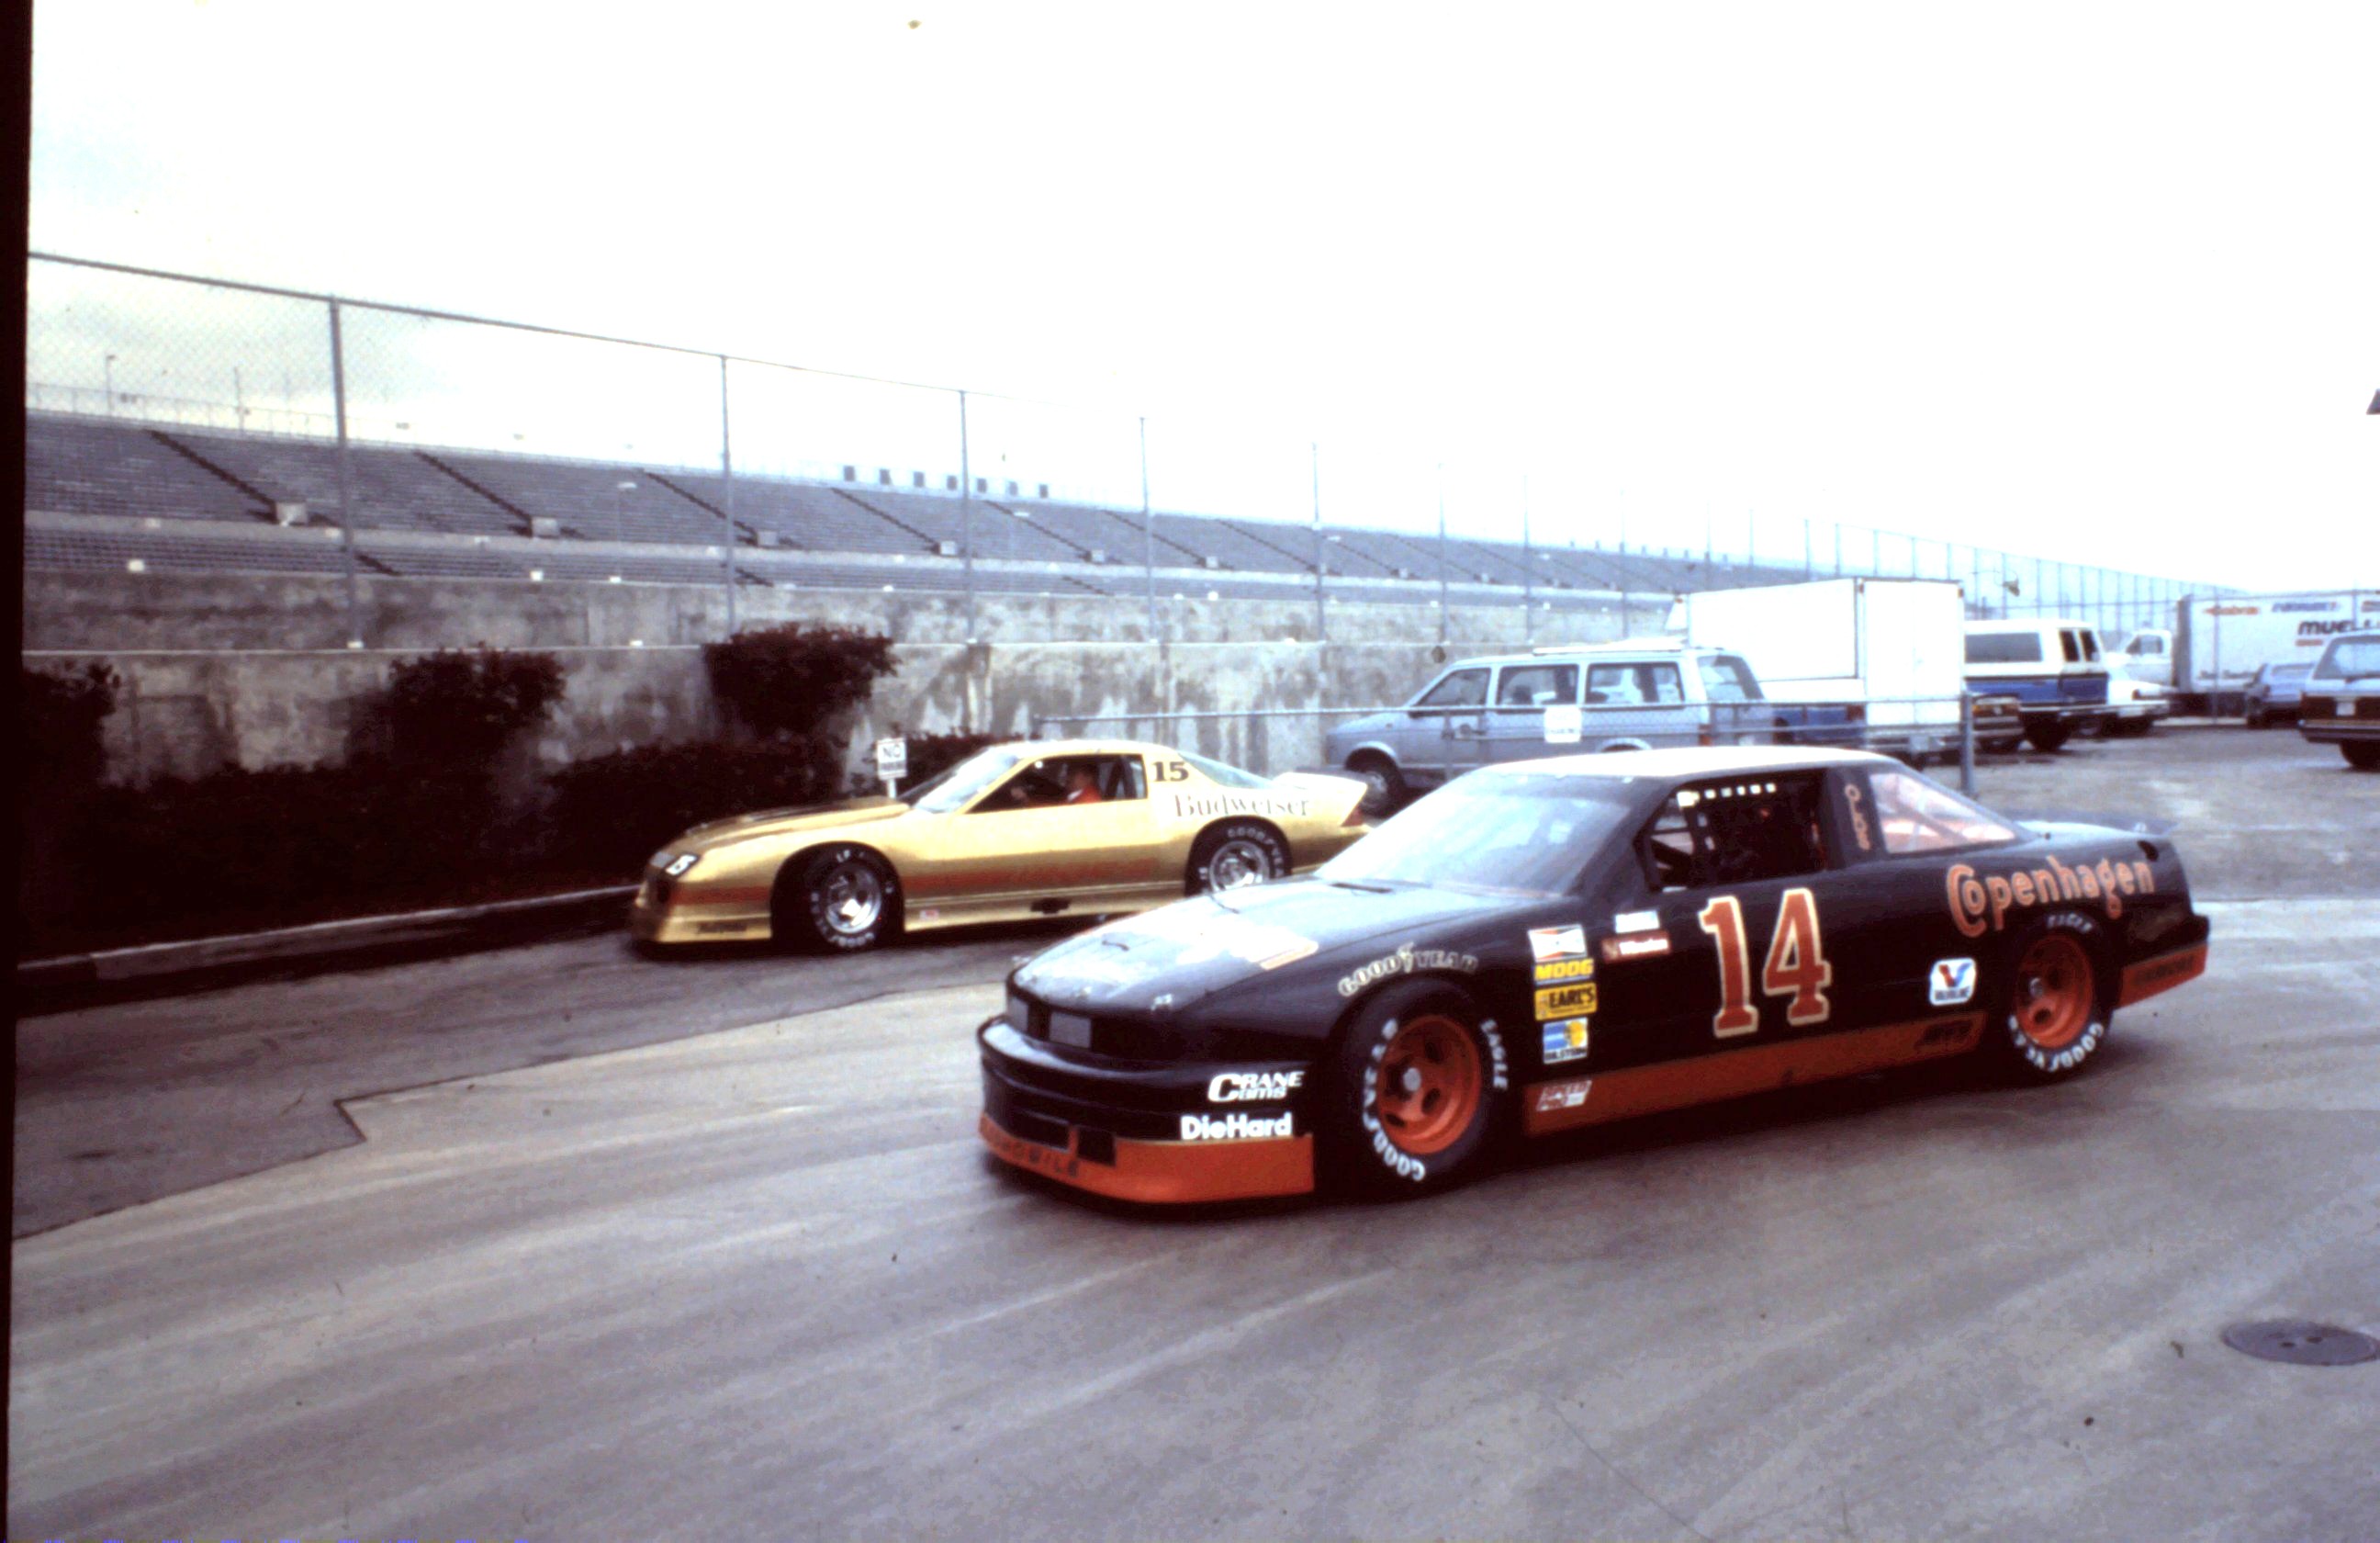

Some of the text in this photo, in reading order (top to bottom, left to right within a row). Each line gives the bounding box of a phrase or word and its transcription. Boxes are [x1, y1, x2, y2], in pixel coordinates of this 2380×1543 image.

[1153, 761, 1189, 782] 15
[1174, 794, 1308, 817] Budweiser
[1947, 853, 2154, 937] Copenhagen
[1534, 958, 1594, 981] MOOG
[1698, 887, 1832, 1039] 14
[1548, 987, 1595, 1008] EARL'S
[1180, 1110, 1293, 1140] DieHard
